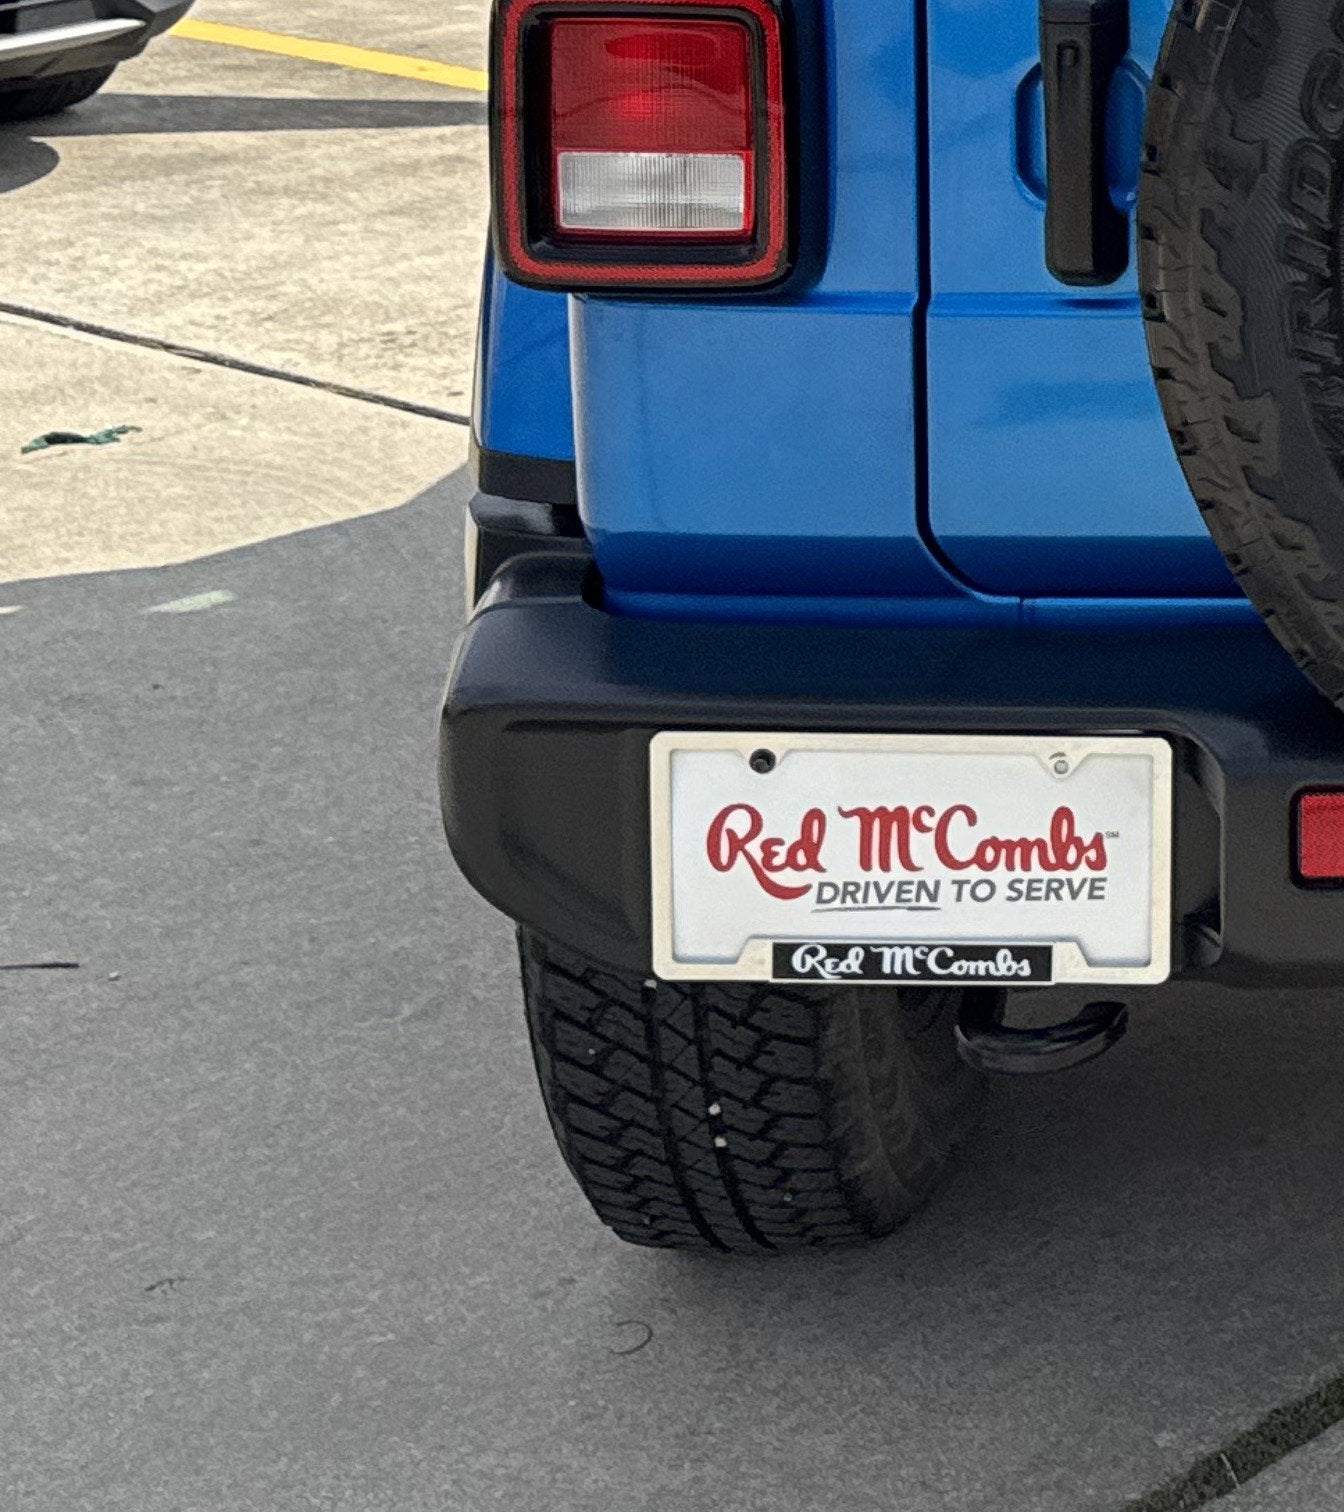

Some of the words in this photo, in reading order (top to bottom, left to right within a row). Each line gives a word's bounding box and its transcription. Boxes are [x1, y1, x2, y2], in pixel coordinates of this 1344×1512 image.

[706, 803, 827, 900] Red
[837, 804, 1108, 872] McCombs
[815, 879, 941, 905] DRIVEN
[951, 879, 997, 903] TO
[1005, 876, 1108, 901] SERVE
[791, 944, 865, 979] Red
[870, 945, 1032, 977] McCombs
